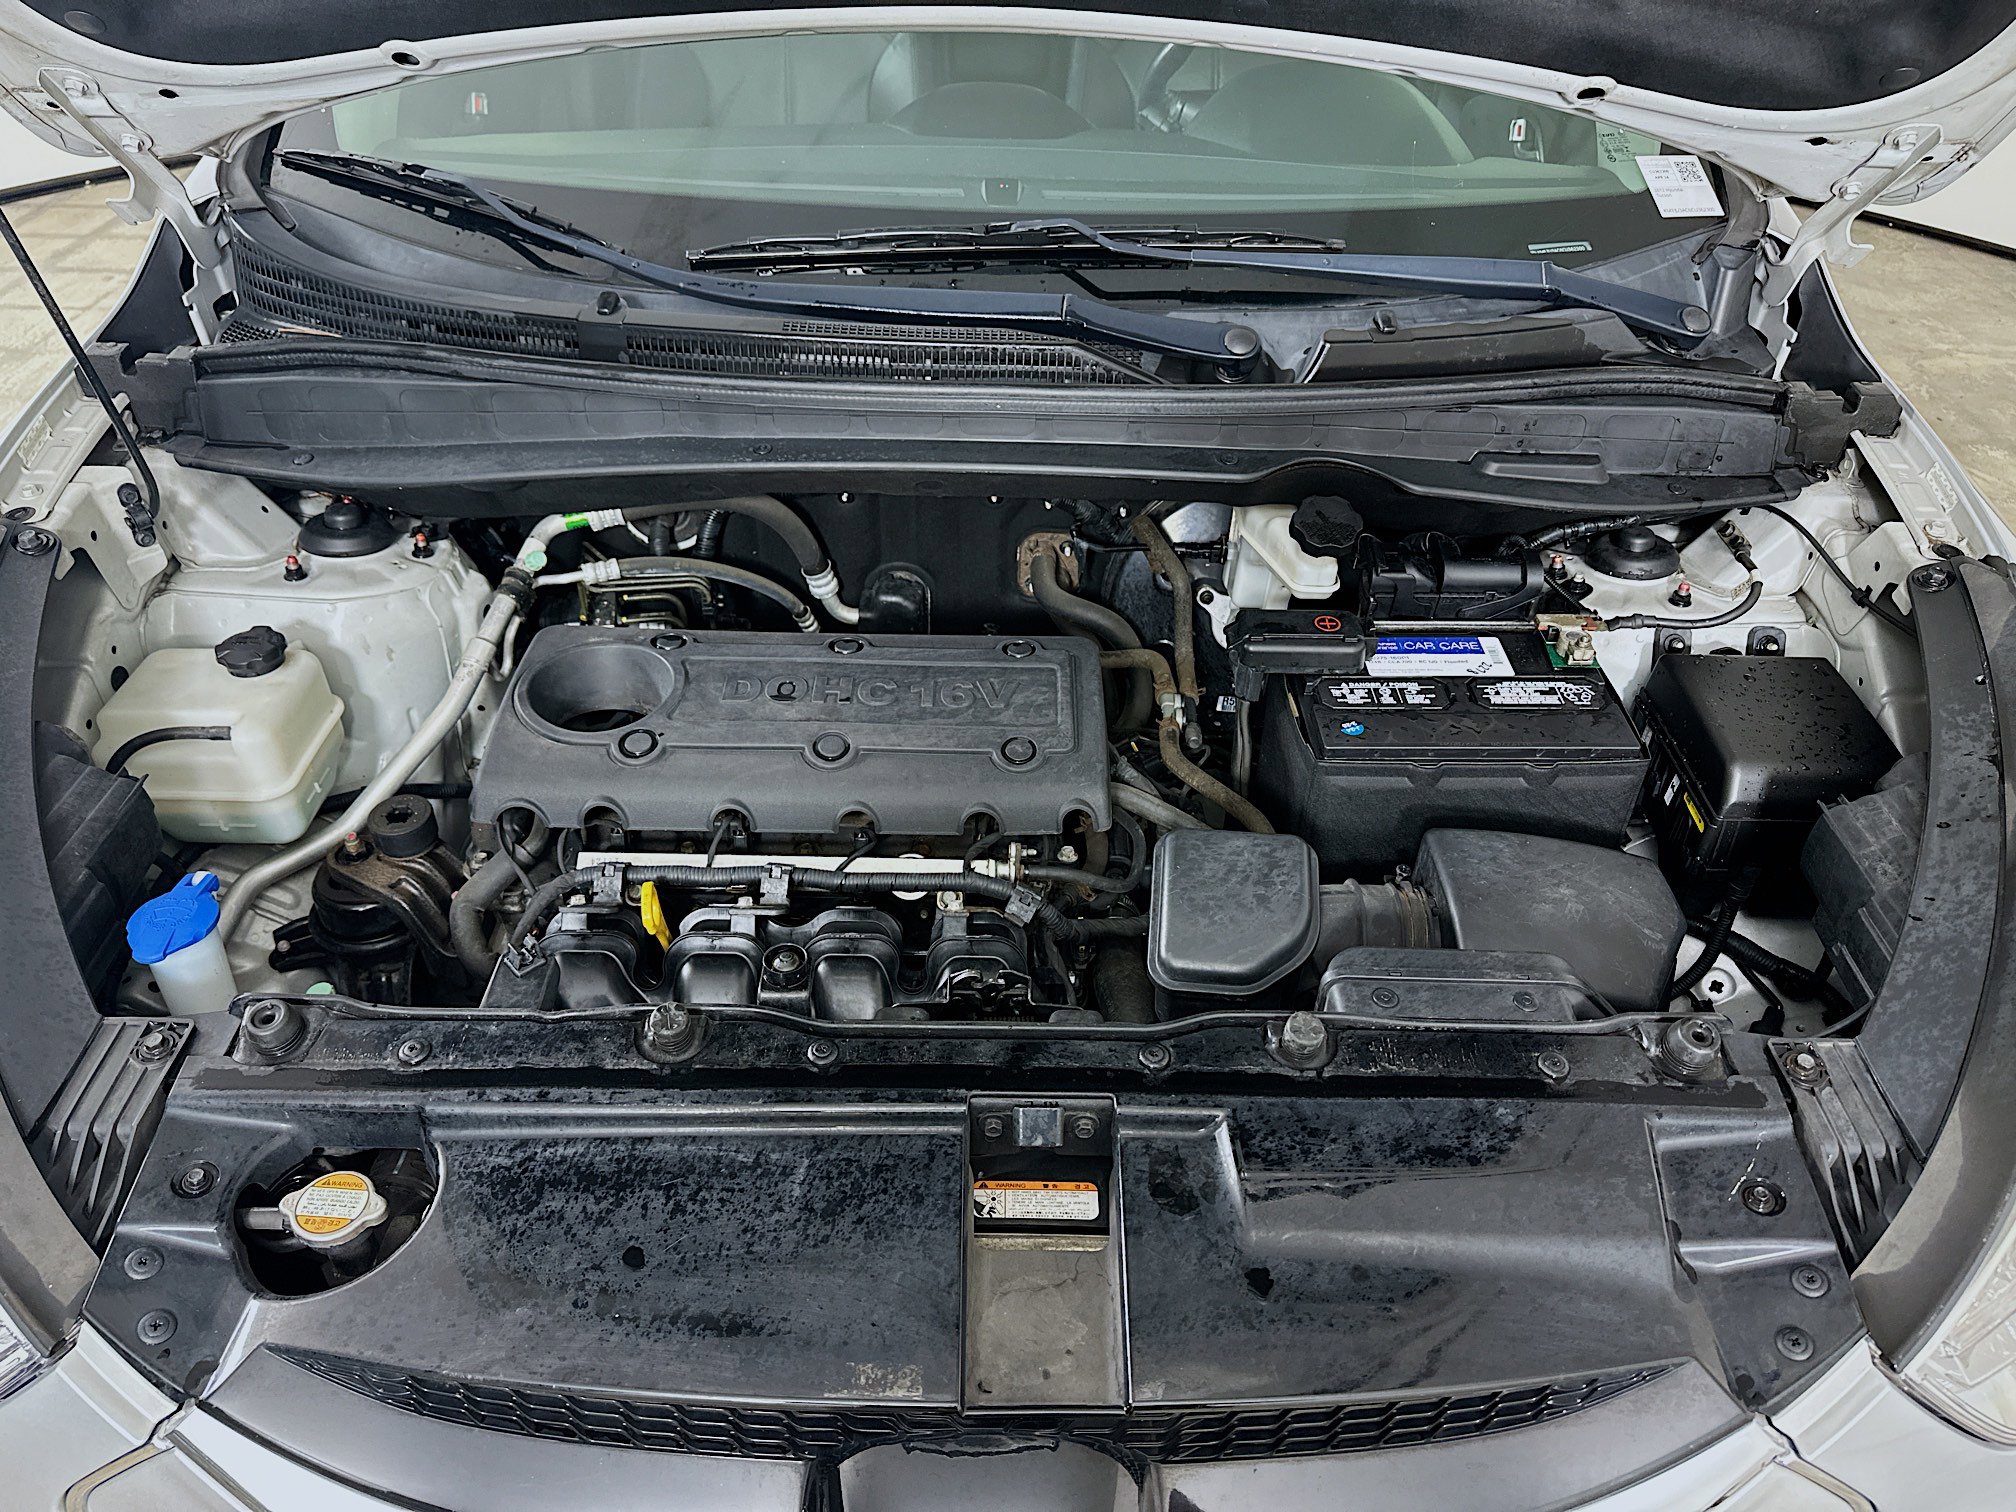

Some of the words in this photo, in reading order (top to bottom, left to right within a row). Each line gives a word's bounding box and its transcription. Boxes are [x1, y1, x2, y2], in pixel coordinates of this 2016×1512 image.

[1404, 641, 1435, 650] CAR
[1439, 641, 1480, 650] CARE
[720, 674, 900, 706] DOHC
[909, 677, 1022, 709] 16V
